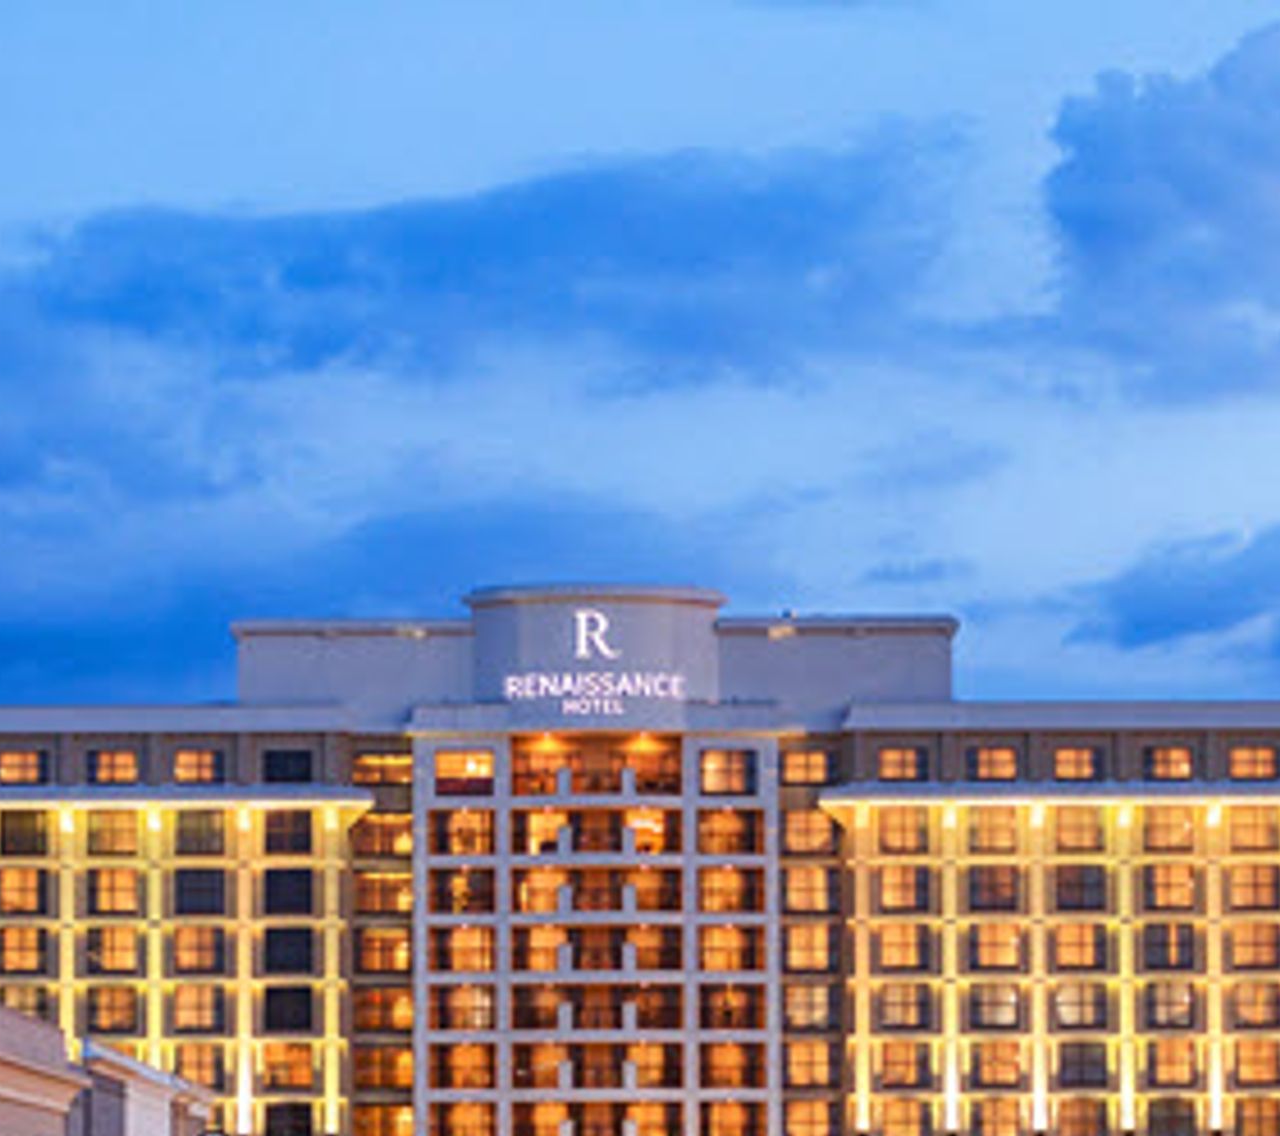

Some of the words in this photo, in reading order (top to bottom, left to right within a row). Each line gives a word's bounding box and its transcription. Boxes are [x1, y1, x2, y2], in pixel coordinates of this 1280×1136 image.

[574, 609, 621, 660] R
[504, 672, 686, 699] RENAISSANCE
[561, 698, 624, 715] HOTEL
